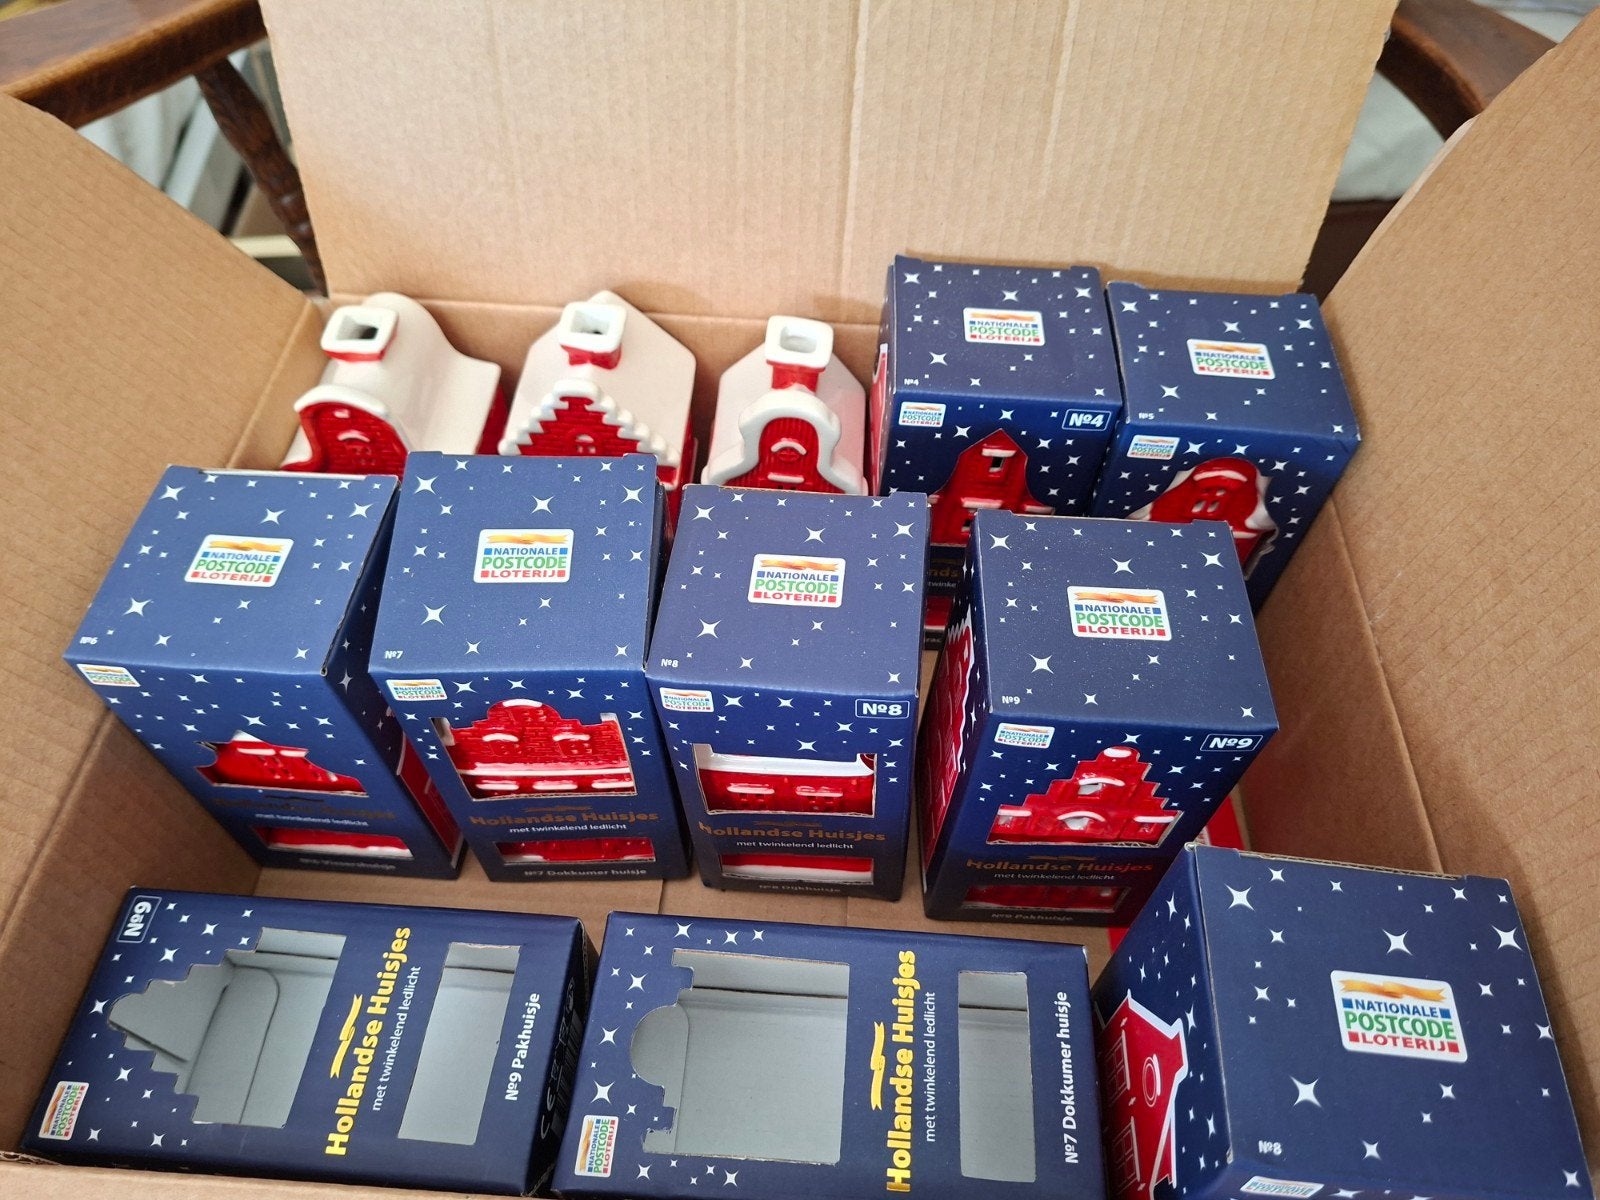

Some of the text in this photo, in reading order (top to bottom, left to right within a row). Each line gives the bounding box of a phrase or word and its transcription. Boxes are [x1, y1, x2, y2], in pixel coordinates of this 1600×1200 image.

[969, 326, 1039, 337] POSTCODE
[977, 320, 1032, 328] NATIONALE
[1196, 357, 1268, 370] POSTCODE
[1203, 352, 1258, 361] NATIONALE
[1207, 367, 1261, 375] LOTERIJ
[902, 414, 941, 422] POSTCODE
[1069, 412, 1105, 428] Nº4
[210, 552, 272, 562] NATIONALE
[494, 547, 558, 555] NATIONALE
[195, 559, 278, 575] POSTCODE
[481, 556, 567, 569] POSTCODE
[200, 571, 264, 582] LOTERIJ
[490, 570, 556, 578] LOTERIJ
[766, 571, 829, 582] NATIONALE
[755, 579, 838, 595] POSTCODE
[763, 592, 827, 603] LOTERIJ
[1085, 604, 1151, 614] NATIONALE
[1075, 612, 1164, 628] POSTCODE
[1088, 625, 1155, 636] LOTERIJ
[862, 702, 903, 716] Nº8
[1209, 737, 1253, 749] Nº9
[470, 811, 659, 826] Hollandse Huisjes
[531, 824, 588, 833] twinkelend
[590, 822, 627, 831] ledlicht
[699, 820, 887, 842] Hollandse Huisjes
[758, 840, 815, 849] twinkelend
[816, 842, 854, 850] ledlicht
[547, 869, 609, 877] Dokkumer
[611, 868, 648, 876] huisje
[966, 858, 1153, 874] Hollandse Huisjes
[123, 901, 152, 937] Nº9
[1355, 999, 1439, 1018] NATIONALE
[1344, 1010, 1457, 1040] POSTCODE
[325, 927, 411, 1157] Hollandse Huisjes
[372, 966, 421, 1111] met twinkelend ledlicht
[1361, 1032, 1446, 1052] LOTERIJ
[505, 993, 541, 1101] Nº9 Pakhuisje
[886, 950, 921, 1193] Hollandse Huisjes
[923, 991, 936, 1142] met twinkelend ledlicht
[1054, 991, 1079, 1164] Nº7 Dokkumer huisje
[53, 1090, 70, 1130] NATIONALE
[56, 1084, 80, 1137] POSTCODE
[66, 1091, 83, 1131] LOTERIJ
[588, 1124, 600, 1166] NATIONALE
[593, 1119, 610, 1173] POSTCODE
[603, 1126, 615, 1167] LOTERIJ
